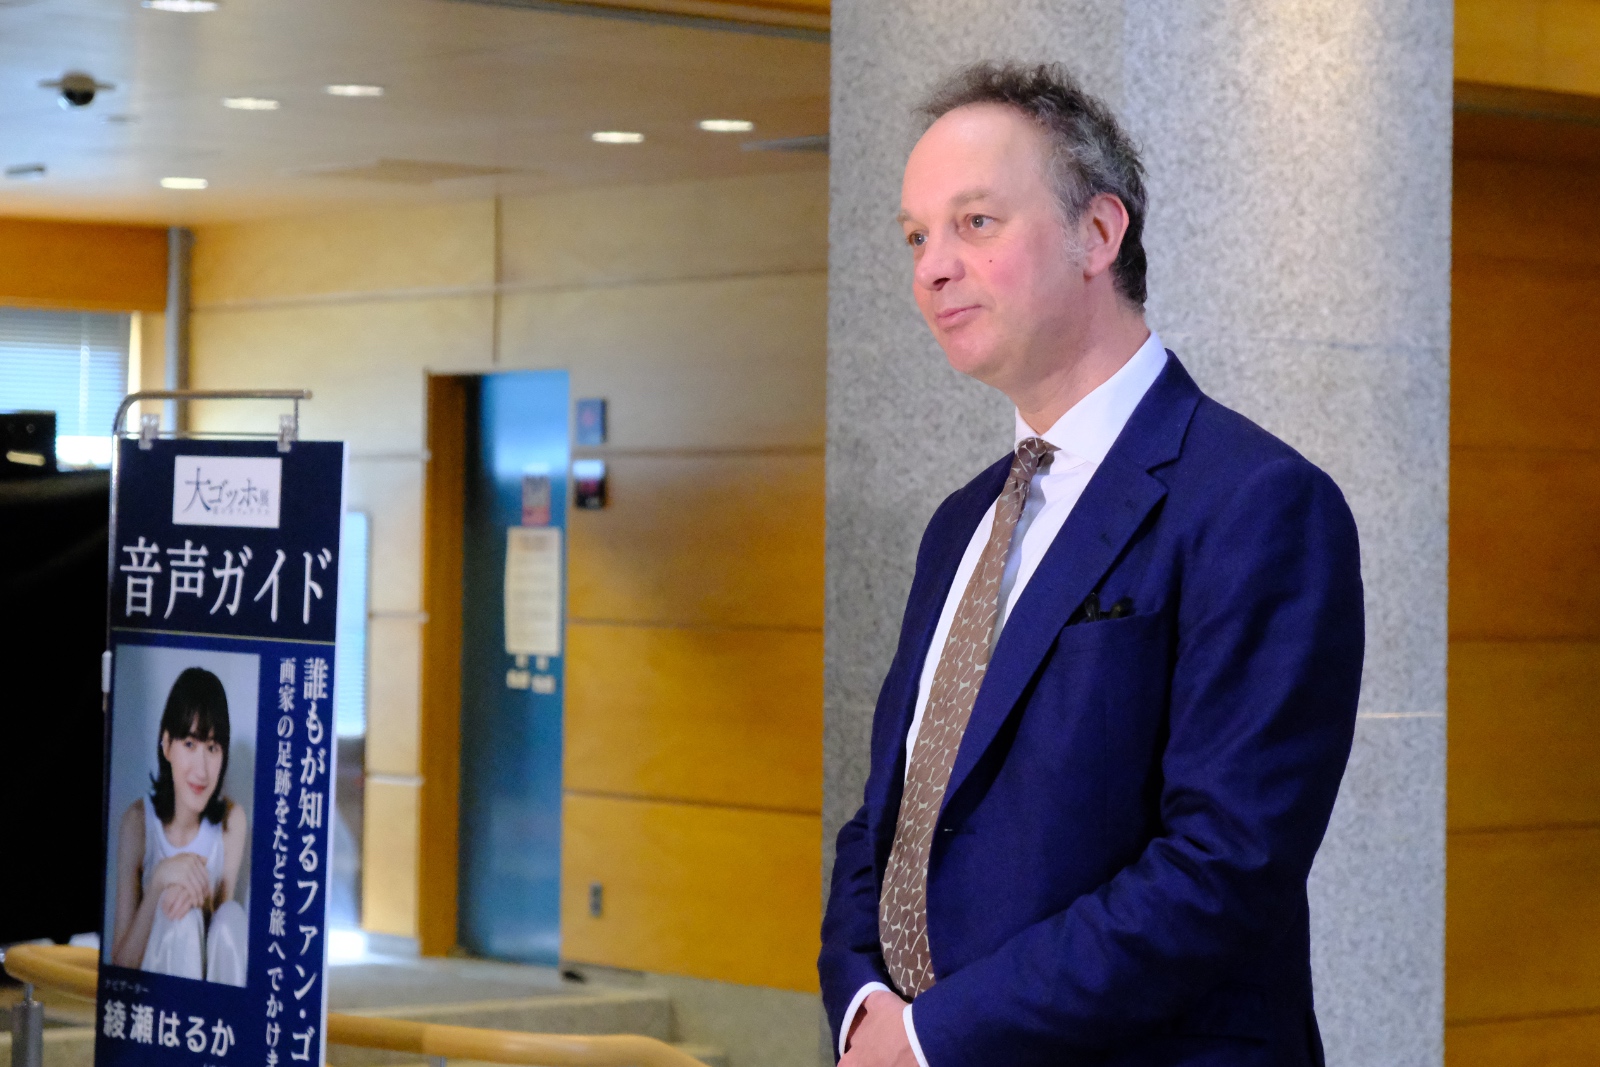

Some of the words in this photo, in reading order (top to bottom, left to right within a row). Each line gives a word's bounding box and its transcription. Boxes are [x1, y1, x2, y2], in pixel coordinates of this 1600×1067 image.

[120, 536, 332, 624] 音声ガイド
[103, 999, 236, 1057] 綾瀬はるか
